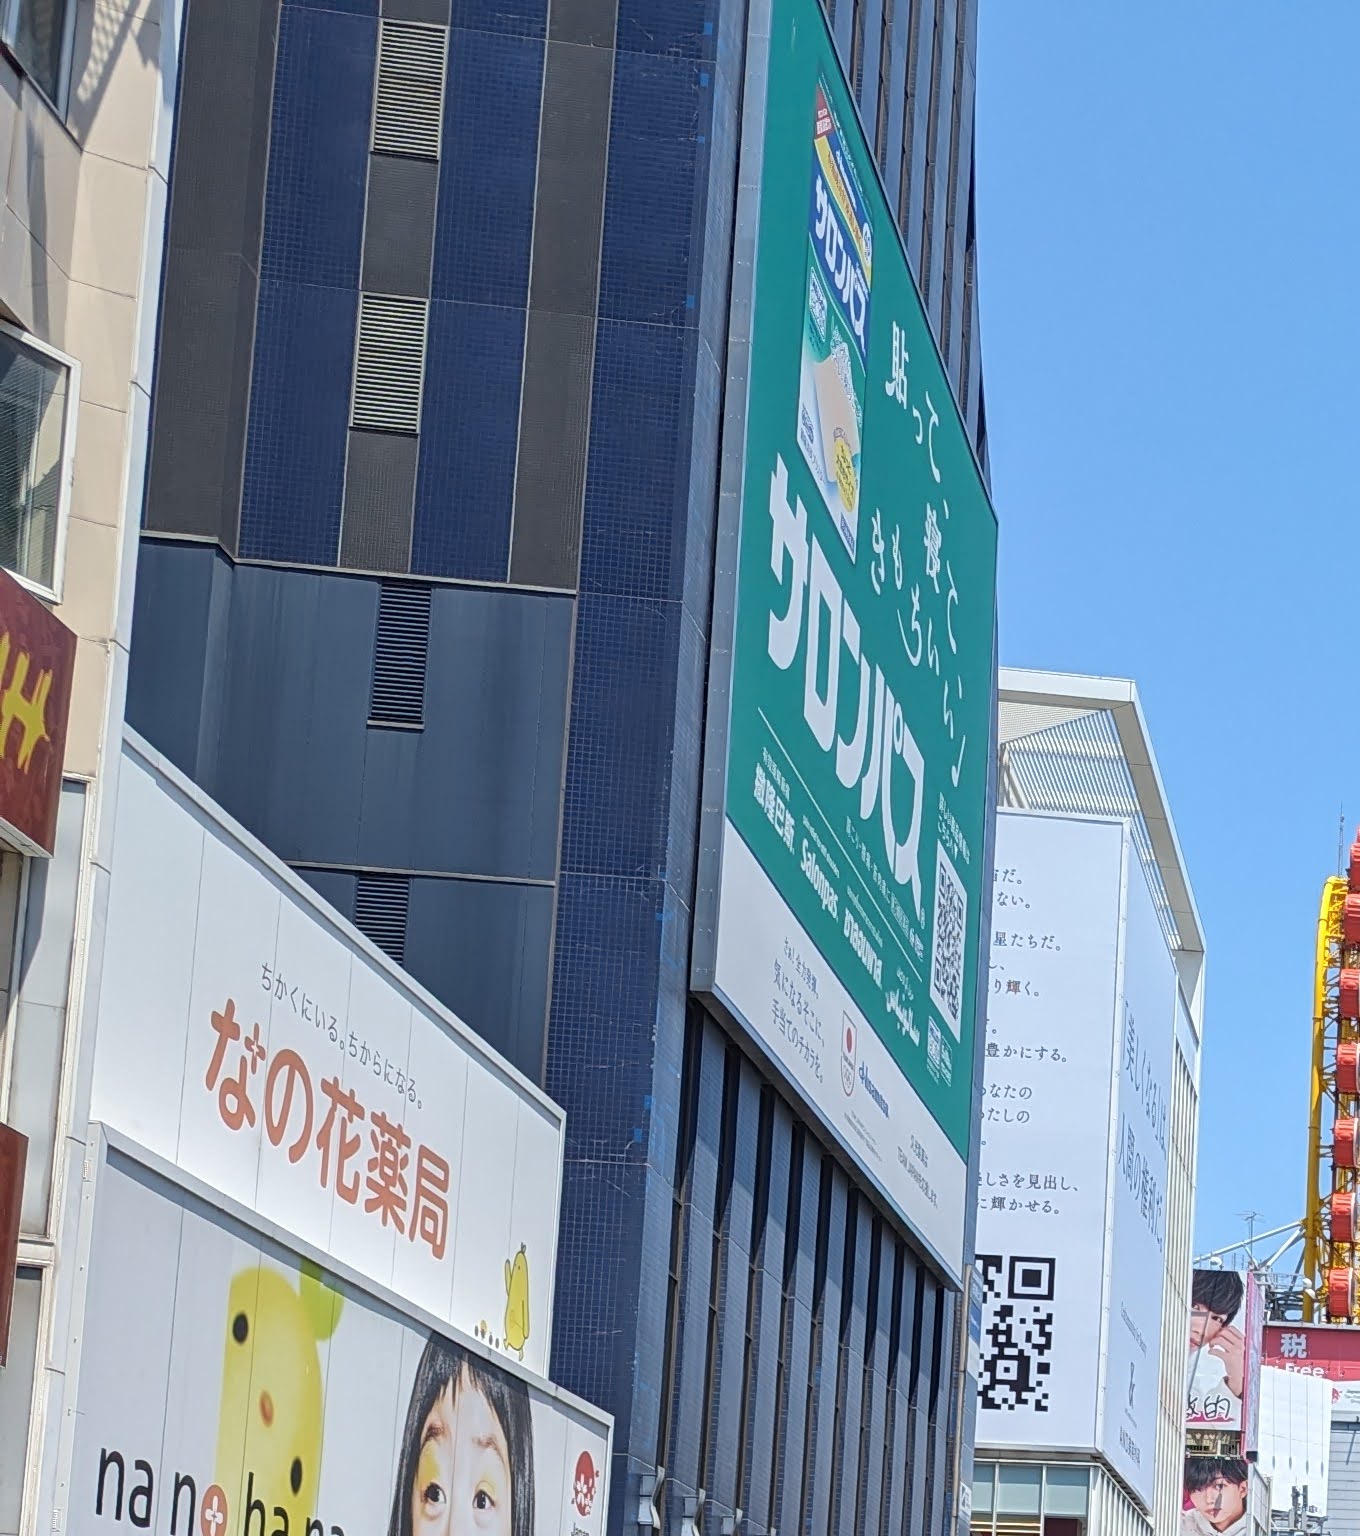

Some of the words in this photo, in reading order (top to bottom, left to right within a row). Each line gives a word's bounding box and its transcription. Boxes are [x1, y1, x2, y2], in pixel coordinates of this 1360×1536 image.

[815, 174, 867, 354] サロンパス
[767, 453, 925, 917] サロンパス
[206, 997, 451, 1261] なの花薬局
[1280, 1332, 1308, 1359] 税
